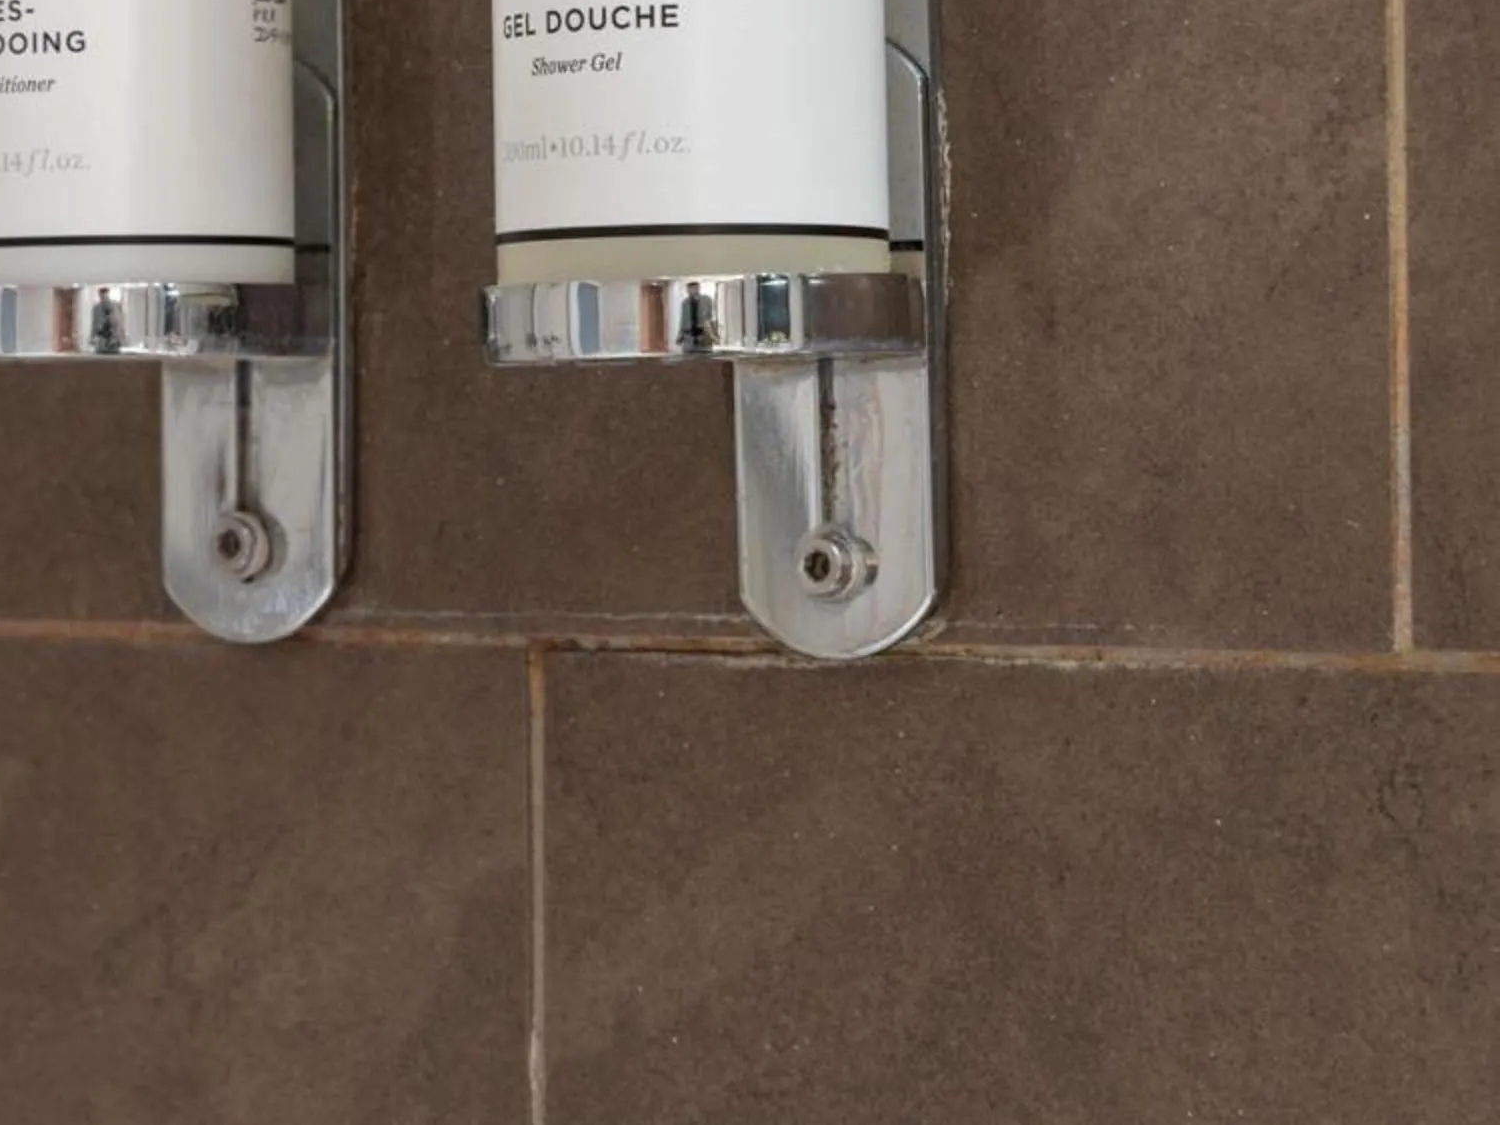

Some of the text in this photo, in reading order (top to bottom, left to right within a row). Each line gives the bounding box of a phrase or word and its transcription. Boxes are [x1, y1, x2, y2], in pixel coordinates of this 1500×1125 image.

[502, 3, 680, 40] GEL DOUCHE
[530, 50, 624, 77] Shower Gel
